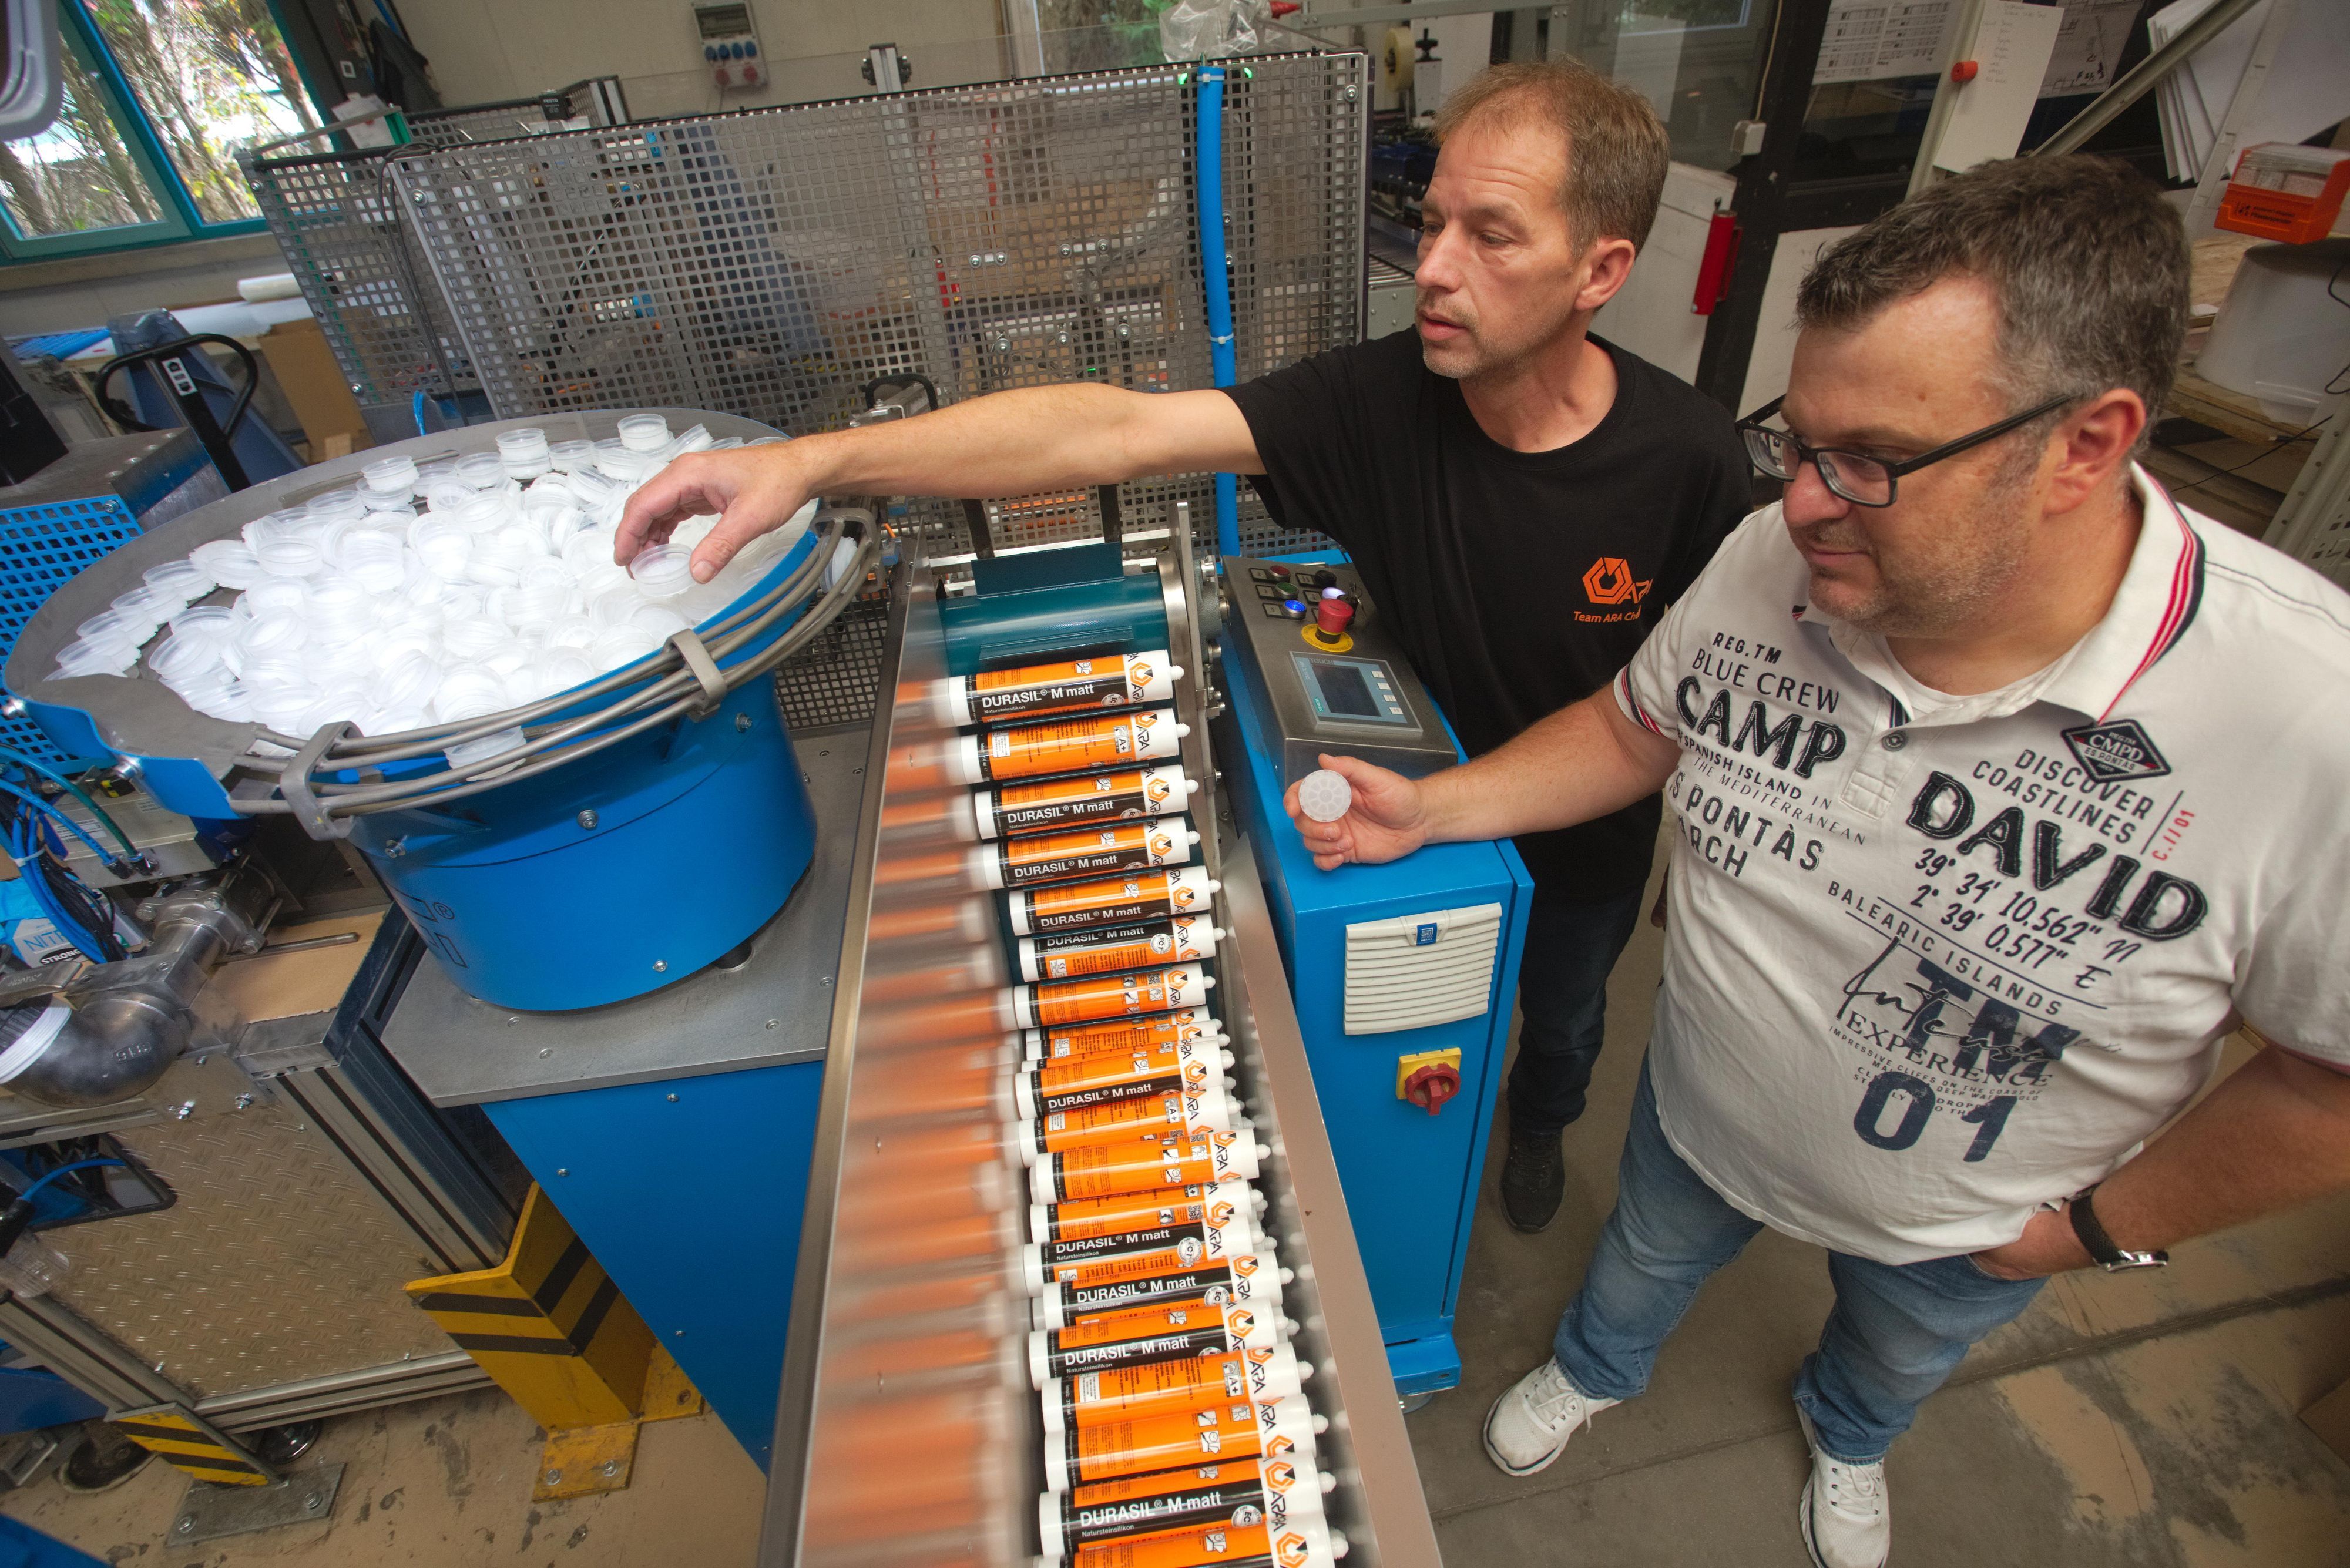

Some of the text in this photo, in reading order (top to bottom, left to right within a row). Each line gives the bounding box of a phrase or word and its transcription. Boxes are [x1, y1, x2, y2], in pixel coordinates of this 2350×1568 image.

[1573, 611, 1602, 623] Team
[1603, 613, 1623, 623] ARA
[1692, 648, 1839, 714] BLUE CREW
[1051, 687, 1063, 699] M
[1067, 684, 1095, 697] matt
[984, 706, 1025, 714] Natursteinsilikon
[1676, 676, 1847, 779] CAMP
[1136, 725, 1151, 751] ARA
[2089, 734, 2144, 762] CMPD
[1146, 767, 1155, 778] RA
[1684, 737, 1832, 810] SPANISH ISLAND IN
[2015, 749, 2155, 820] DISCOVER
[1073, 803, 1085, 814] M
[1087, 801, 1113, 812] matt
[1693, 757, 1866, 846] THE MEDITERRANEAN
[1972, 761, 2137, 844] COASTLINES
[1009, 820, 1049, 829] Natursteinsilikon
[1147, 820, 1158, 833] RA
[1078, 858, 1089, 869] M
[1092, 855, 1117, 867] matt
[1906, 770, 2208, 940] DAVID
[1103, 909, 1114, 918] M
[1116, 906, 1142, 916] matt
[1107, 930, 1117, 939] M
[1120, 926, 1145, 936] matt
[1176, 925, 1189, 948] ARA
[1048, 944, 1085, 952] Natursteinsilikon
[1827, 881, 2063, 1016] BALEARIC ISLANDS
[1169, 987, 1181, 1007] ARA
[1845, 1010, 2053, 1087] EXPERIENCE
[1829, 1026, 1893, 1067] IMPRESSIVE
[1897, 1065, 1936, 1083] CLIFFS
[1963, 1085, 1985, 1094] THE
[1112, 1087, 1124, 1097] M
[1127, 1084, 1152, 1094] matt
[1936, 1086, 1965, 1096] DEEP
[1186, 1096, 1199, 1121] ARA
[1854, 1070, 2018, 1163] 01
[1215, 1143, 1229, 1171] ARA
[1126, 1233, 1139, 1244] M
[1142, 1230, 1170, 1241] matt
[1207, 1226, 1222, 1255] ARA
[1056, 1251, 1099, 1261] Natursteinsilikon
[1150, 1280, 1164, 1292] M
[1167, 1275, 1196, 1289] matt
[1079, 1300, 1123, 1311] Natursteinsilikon
[1142, 1340, 1156, 1354] M
[1159, 1336, 1190, 1351] matt
[1066, 1362, 1113, 1374] Natursteinsilikon
[1249, 1361, 1266, 1394] ARA
[1260, 1402, 1276, 1434] ARA
[1168, 1497, 1183, 1514] M
[1187, 1492, 1223, 1510] matt
[1082, 1524, 1134, 1538] Natursteinsilikon
